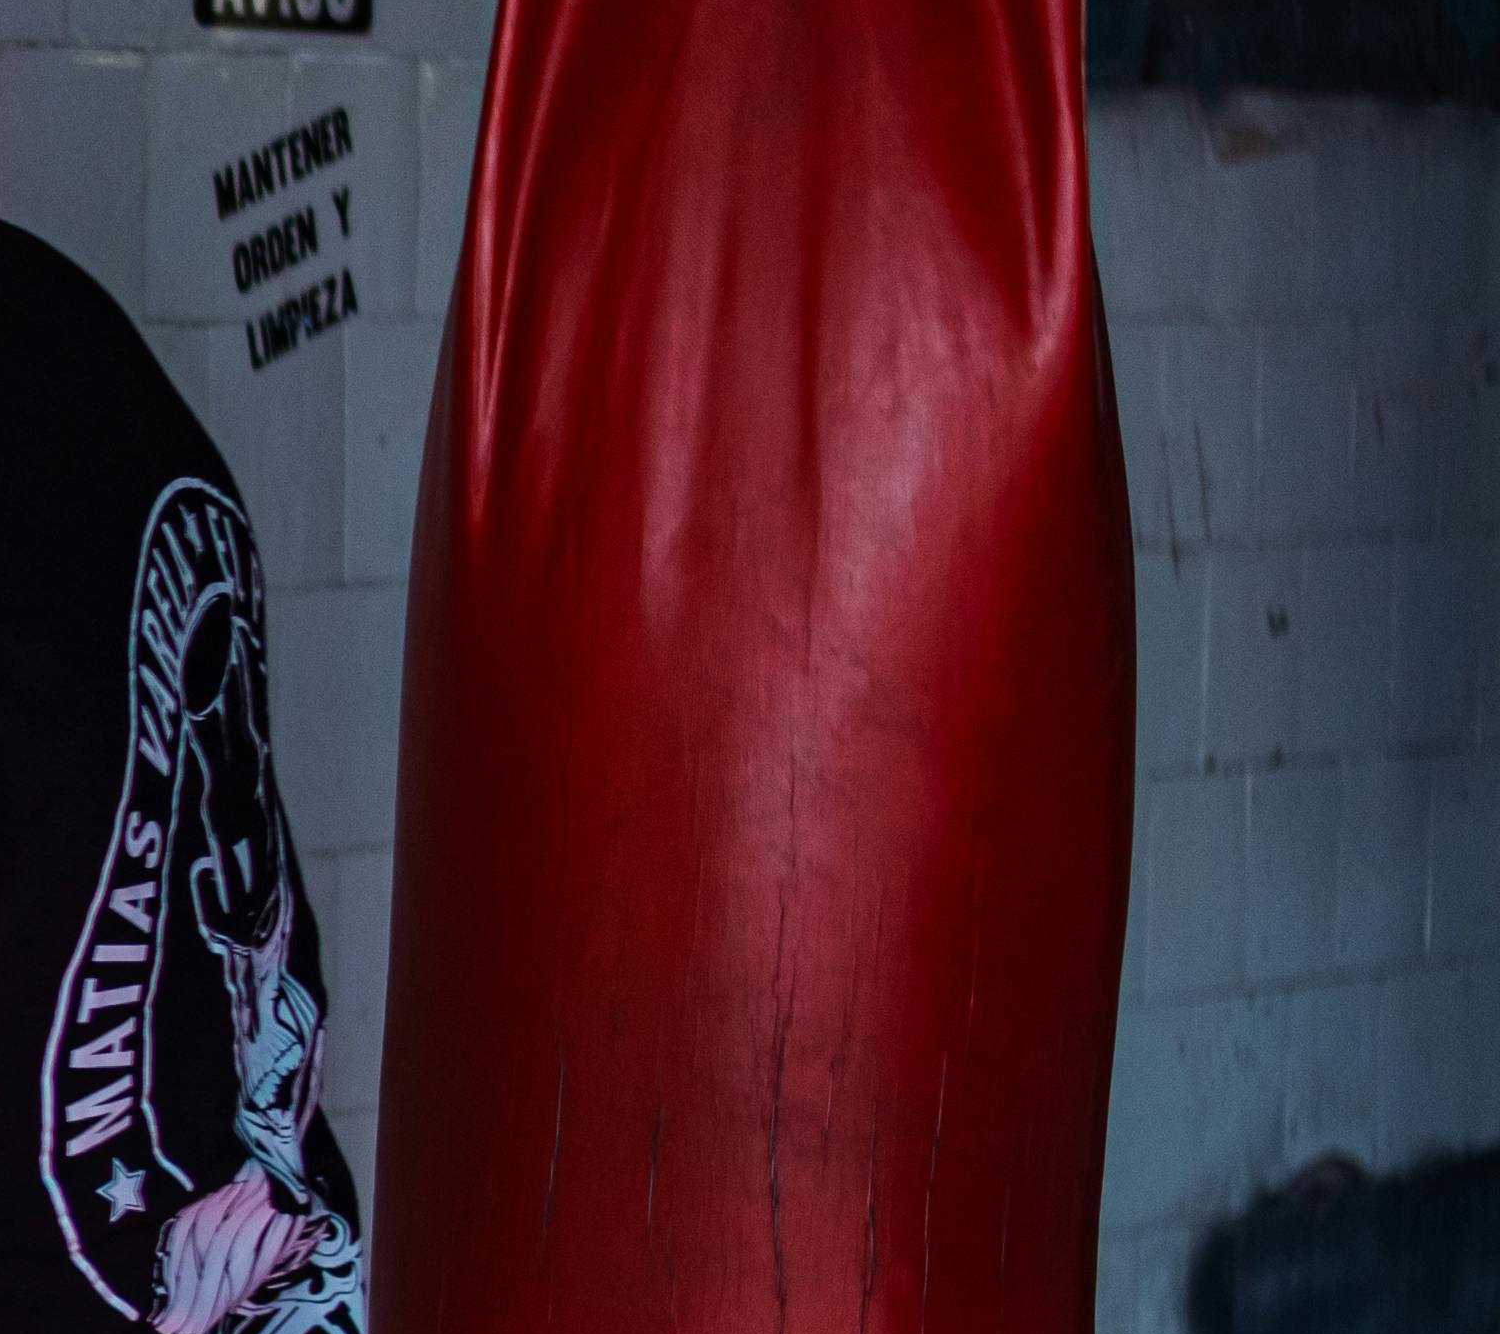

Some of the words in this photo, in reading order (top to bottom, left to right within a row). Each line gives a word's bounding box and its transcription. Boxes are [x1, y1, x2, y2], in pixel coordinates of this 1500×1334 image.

[211, 106, 355, 221] MANTENER
[232, 207, 320, 295] ORDEN
[332, 185, 351, 238] Y
[245, 268, 360, 372] LIMPIEZA
[65, 811, 163, 1157] MATIAS
